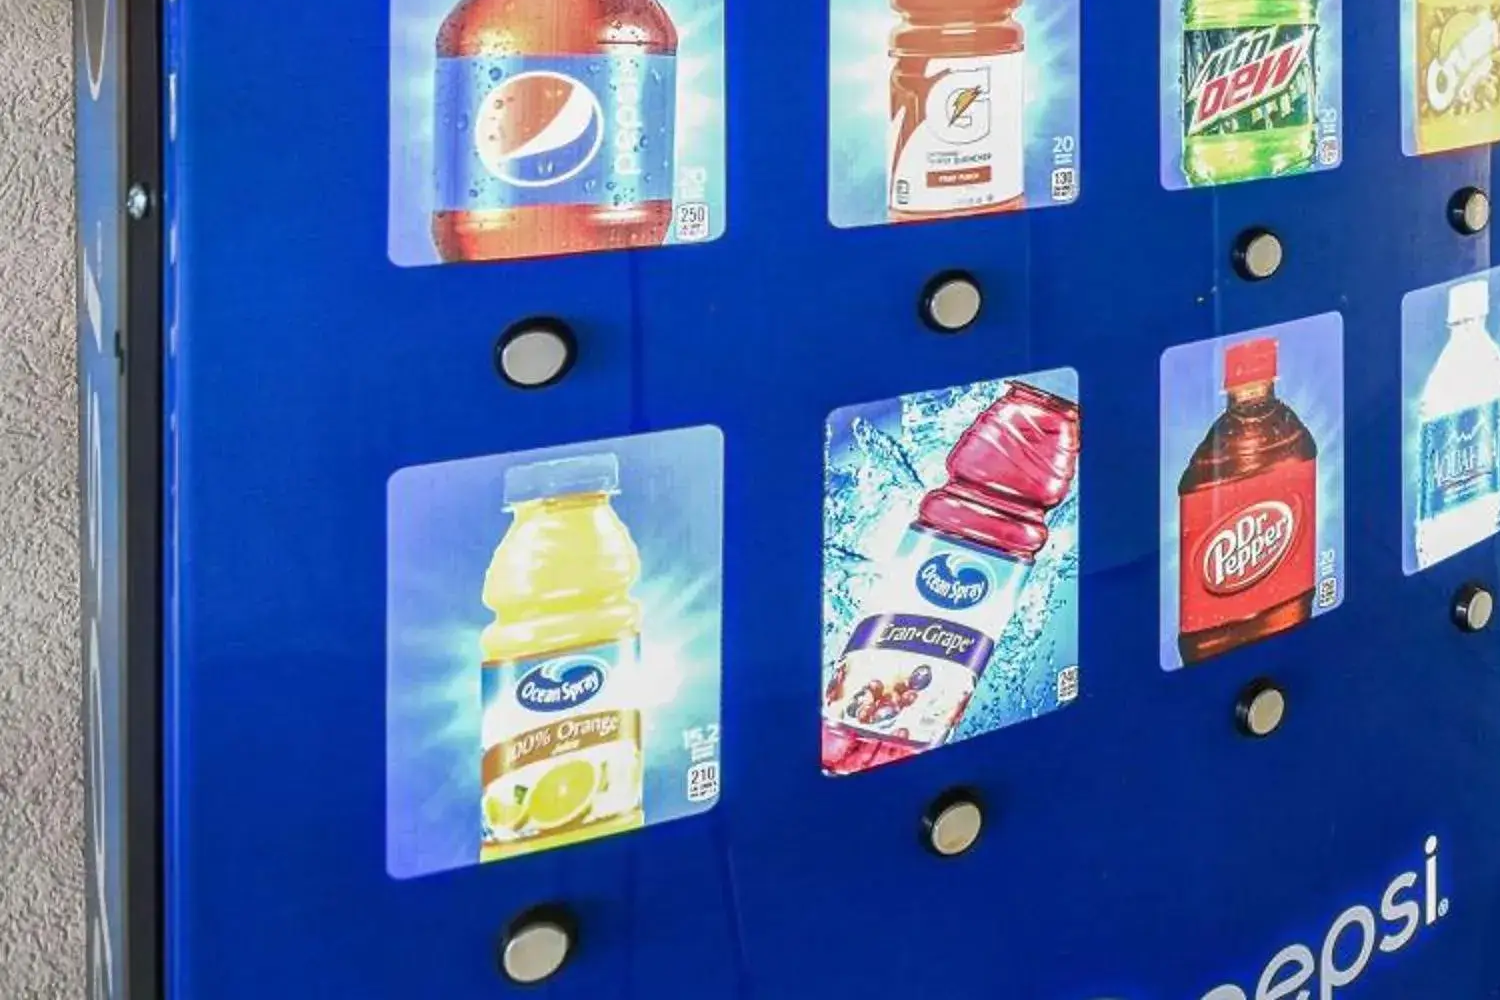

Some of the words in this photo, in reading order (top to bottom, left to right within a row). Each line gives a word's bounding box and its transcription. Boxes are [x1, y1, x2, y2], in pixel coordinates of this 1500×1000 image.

[1052, 135, 1074, 153] 20
[680, 206, 706, 223] 250
[1236, 512, 1268, 550] Dr
[1212, 516, 1288, 585] Pepper
[921, 564, 950, 597] Ocean
[948, 580, 985, 605] Spray
[521, 682, 561, 703] Ocean
[561, 671, 600, 701] Spray
[557, 716, 618, 741] Orange
[691, 766, 715, 785] 210
[1200, 834, 1438, 1000] epsi
